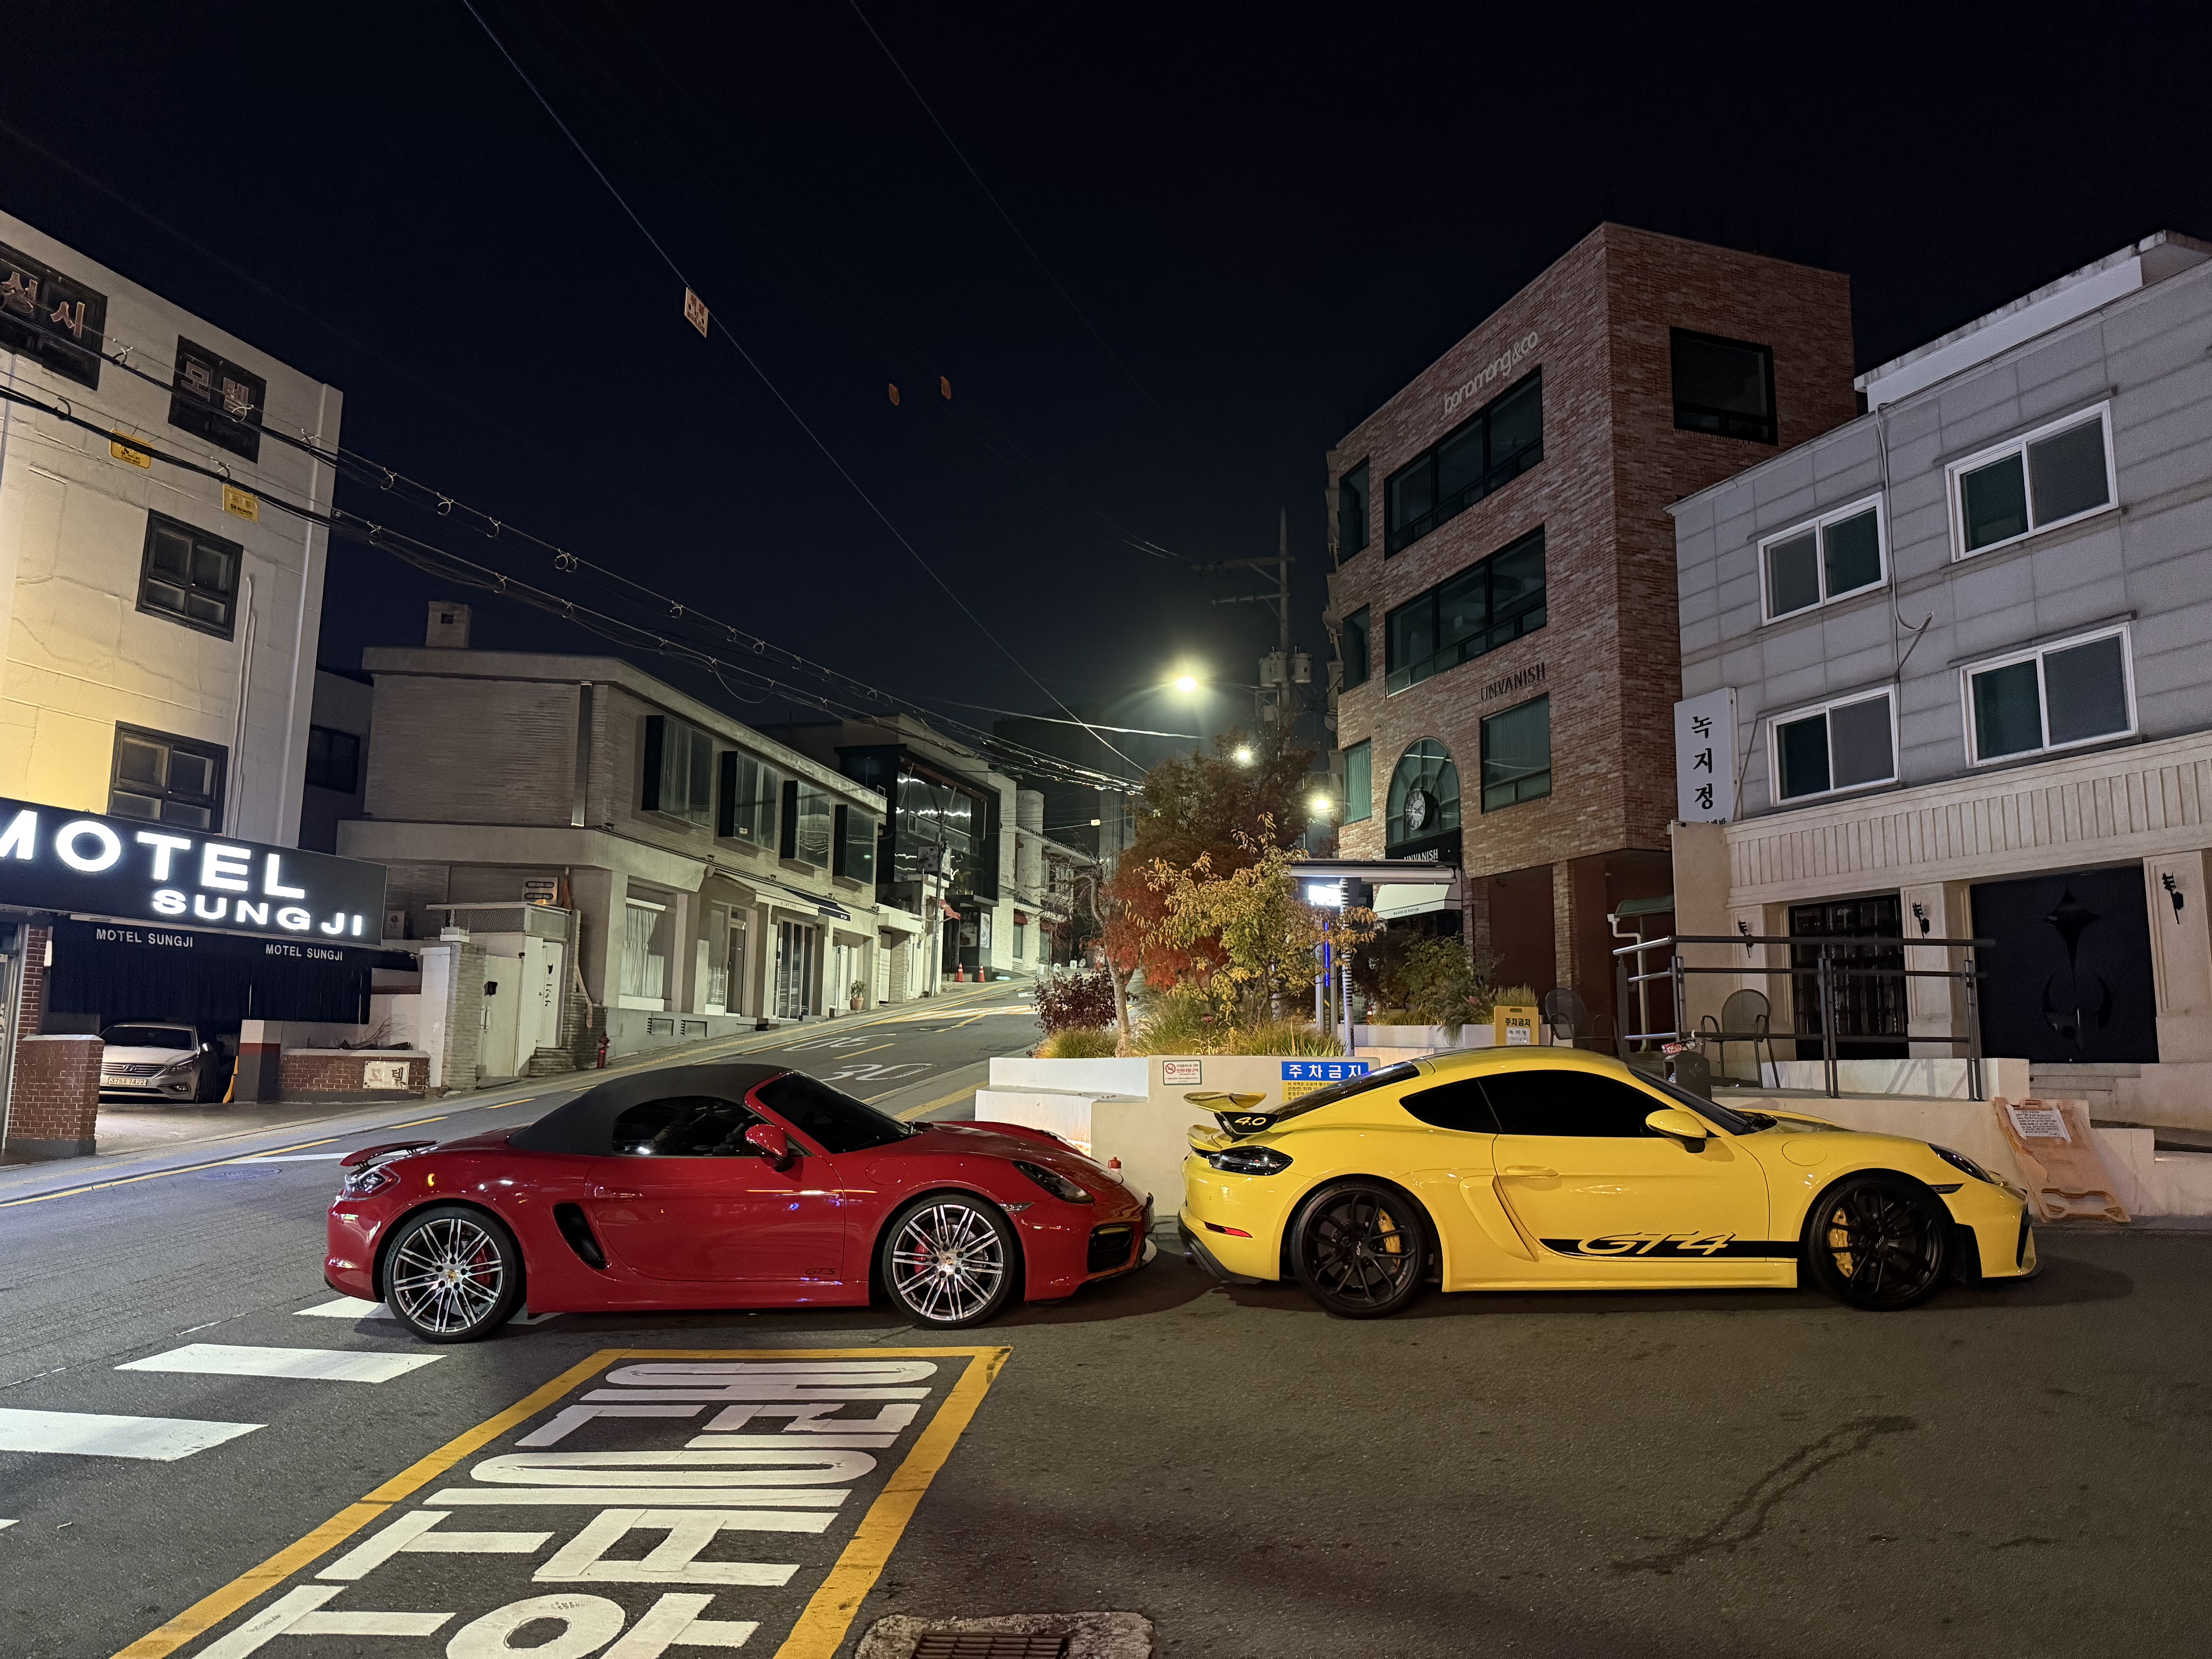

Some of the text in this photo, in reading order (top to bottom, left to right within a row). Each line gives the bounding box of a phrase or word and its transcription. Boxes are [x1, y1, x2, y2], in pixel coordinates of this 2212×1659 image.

[1481, 662, 1545, 702] UNVANISH
[1691, 716, 1713, 809] 녹지정
[153, 890, 362, 936] SUNGJI
[96, 929, 193, 948] MOTEL SUNGJI
[266, 944, 343, 961] MOTEL SUNGJI
[1289, 1065, 1361, 1079] 주차금지
[1235, 1117, 1266, 1126] 4.0
[1578, 1231, 1736, 1255] GT4
